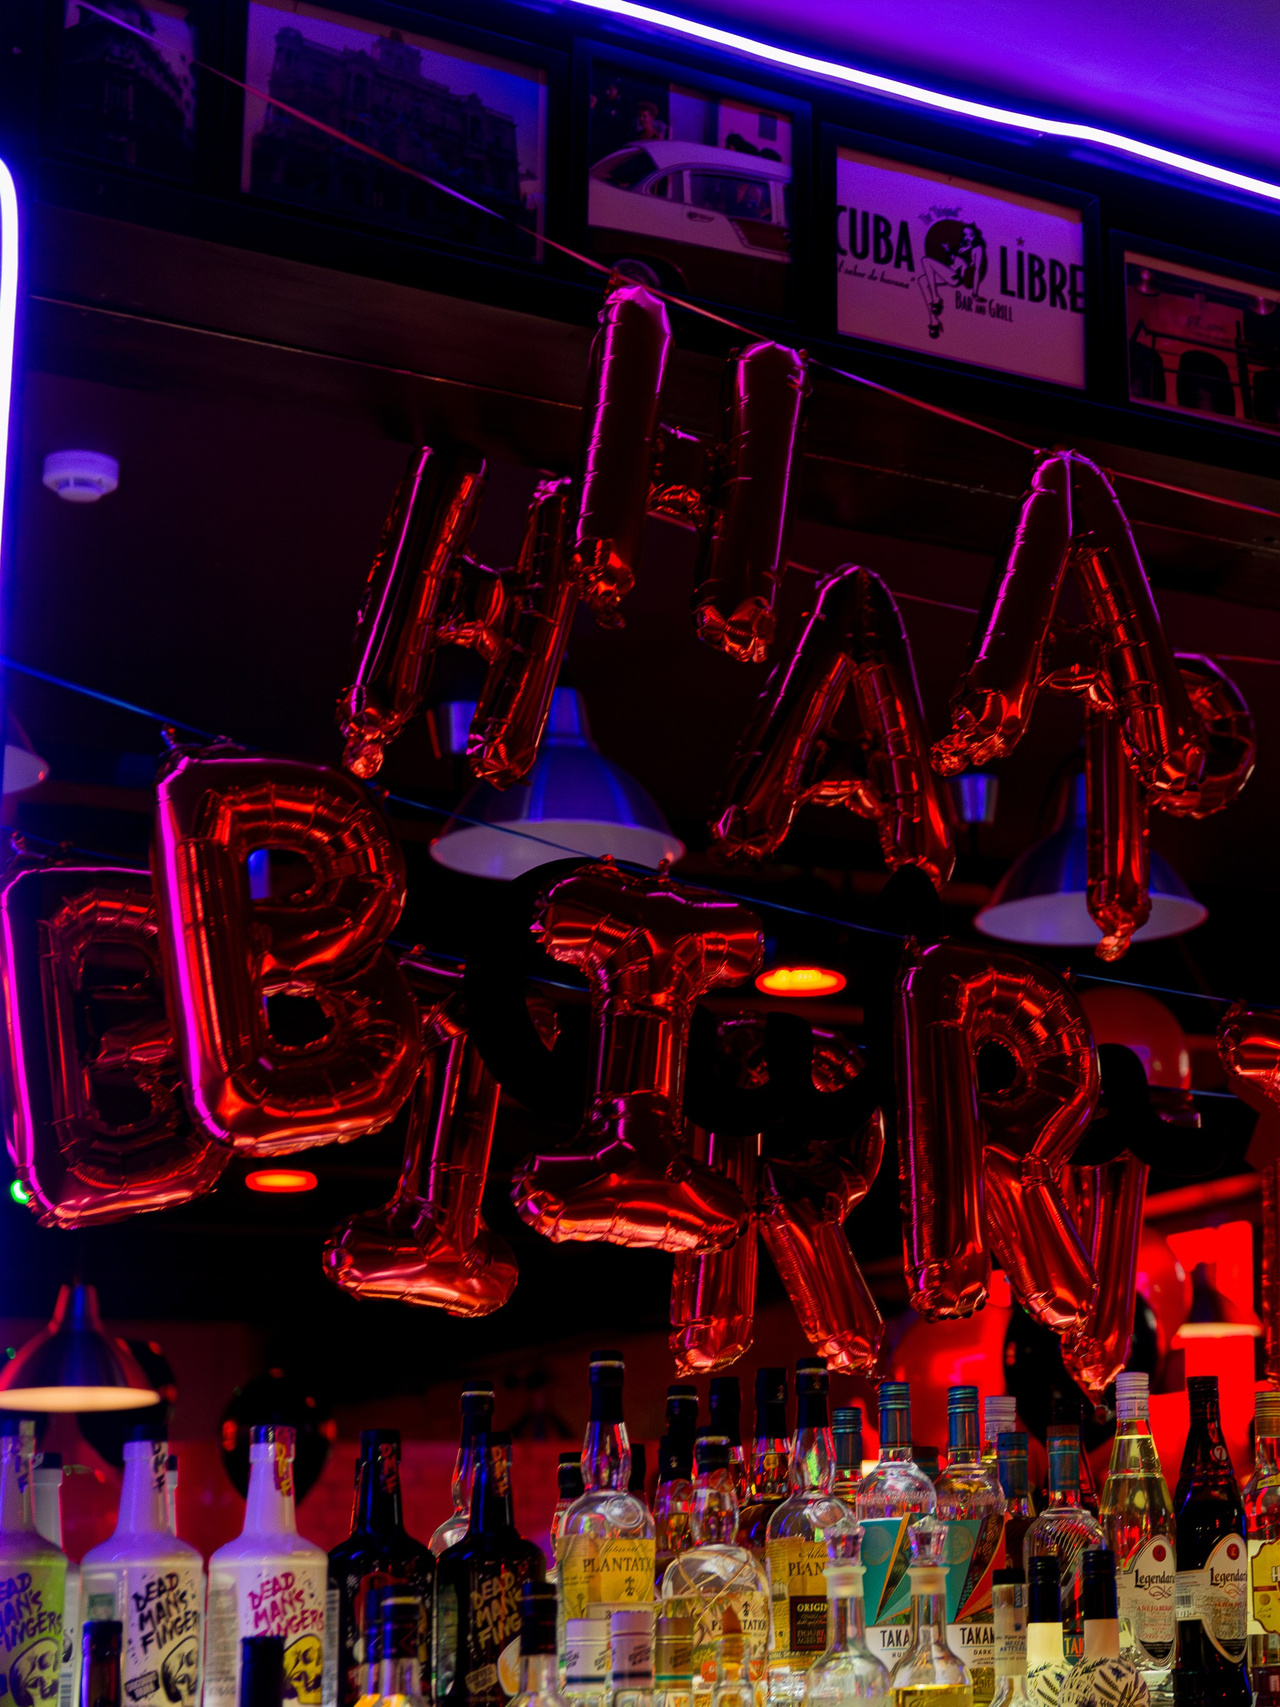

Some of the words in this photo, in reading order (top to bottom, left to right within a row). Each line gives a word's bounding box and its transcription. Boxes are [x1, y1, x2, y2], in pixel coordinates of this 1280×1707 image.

[836, 205, 915, 272] CUBA
[955, 290, 973, 312] BAR
[989, 299, 1013, 322] GRILL
[0, 1572, 32, 1600] EAD
[132, 1573, 179, 1612] DEAD
[247, 1572, 295, 1610] DEAD
[471, 1573, 515, 1609] DEAD
